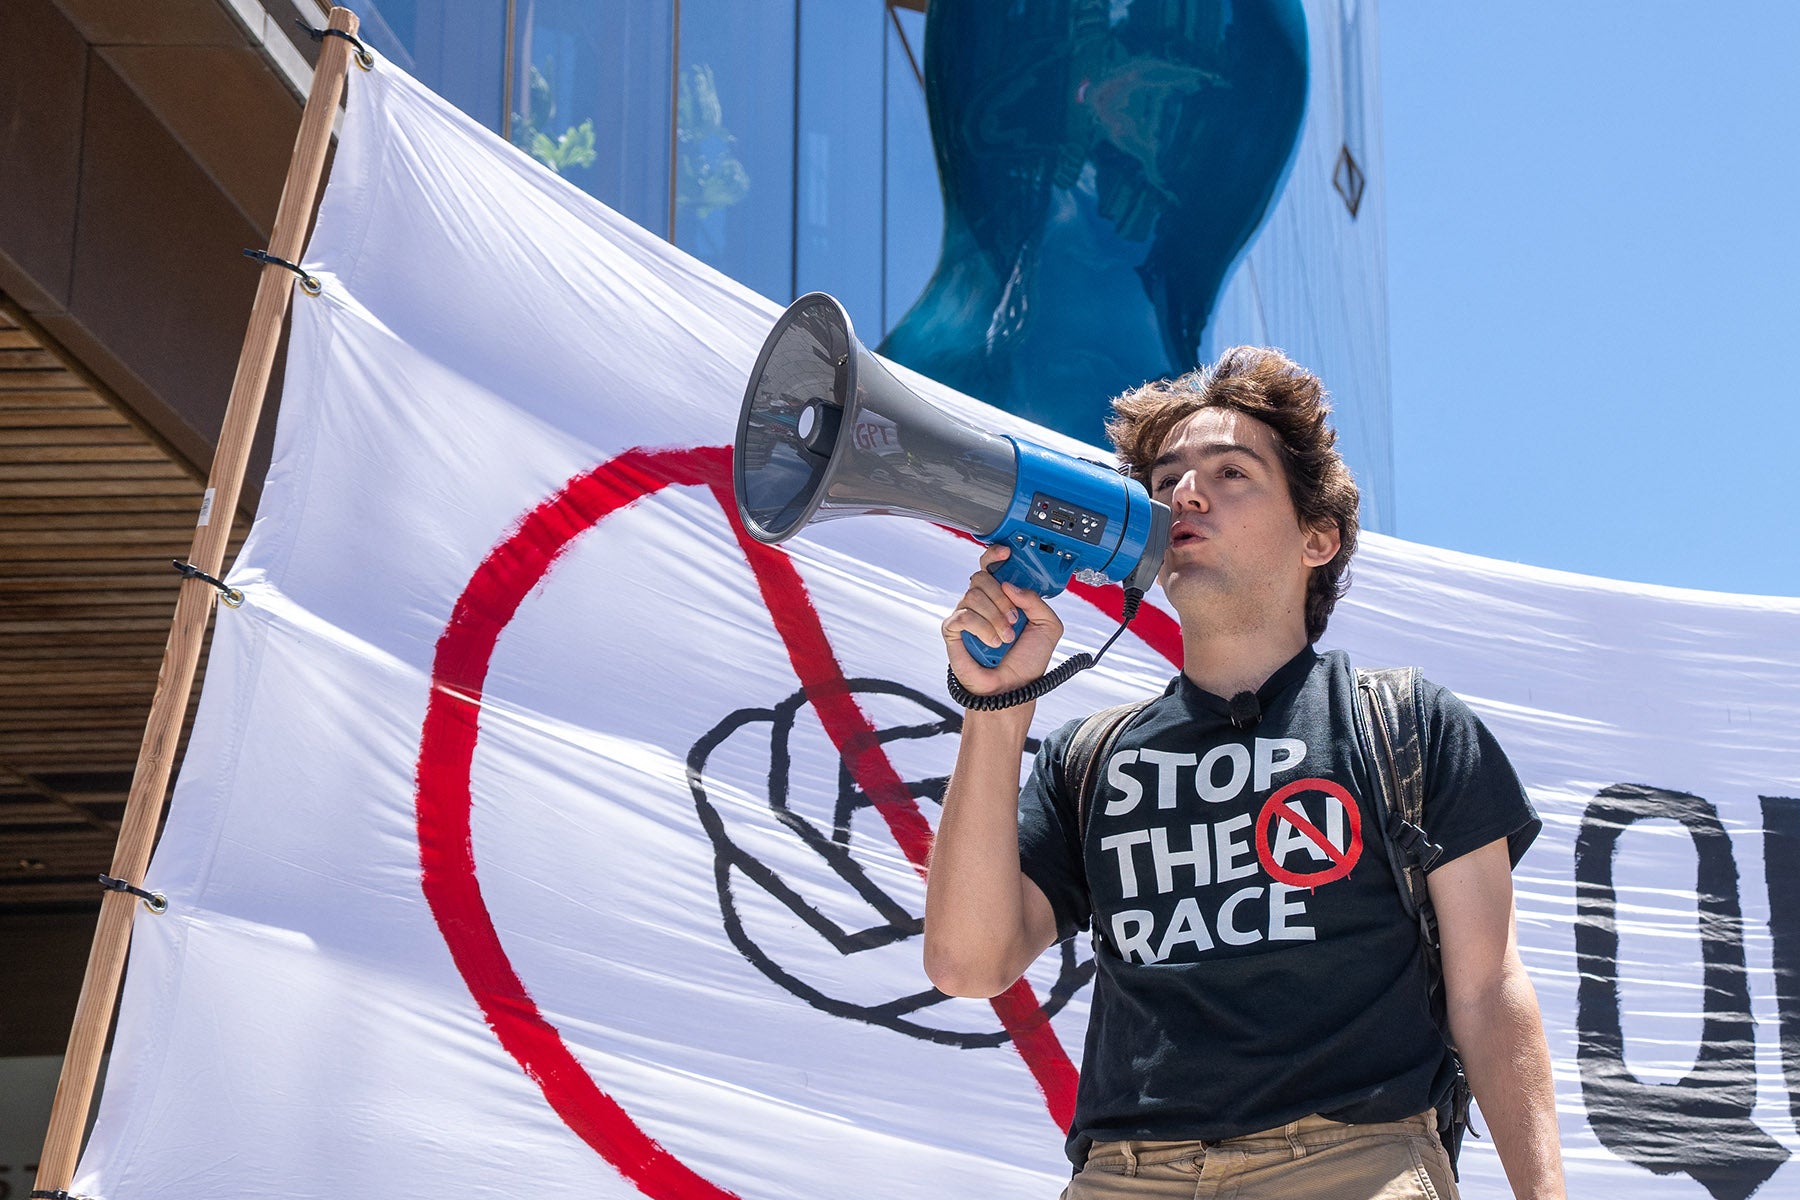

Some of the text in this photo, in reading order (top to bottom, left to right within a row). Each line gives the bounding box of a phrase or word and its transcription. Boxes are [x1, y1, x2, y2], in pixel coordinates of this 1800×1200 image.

[855, 422, 889, 449] GPT
[1104, 737, 1308, 817] STOP
[1101, 797, 1344, 899] THE AI
[1111, 883, 1317, 966] RACE
